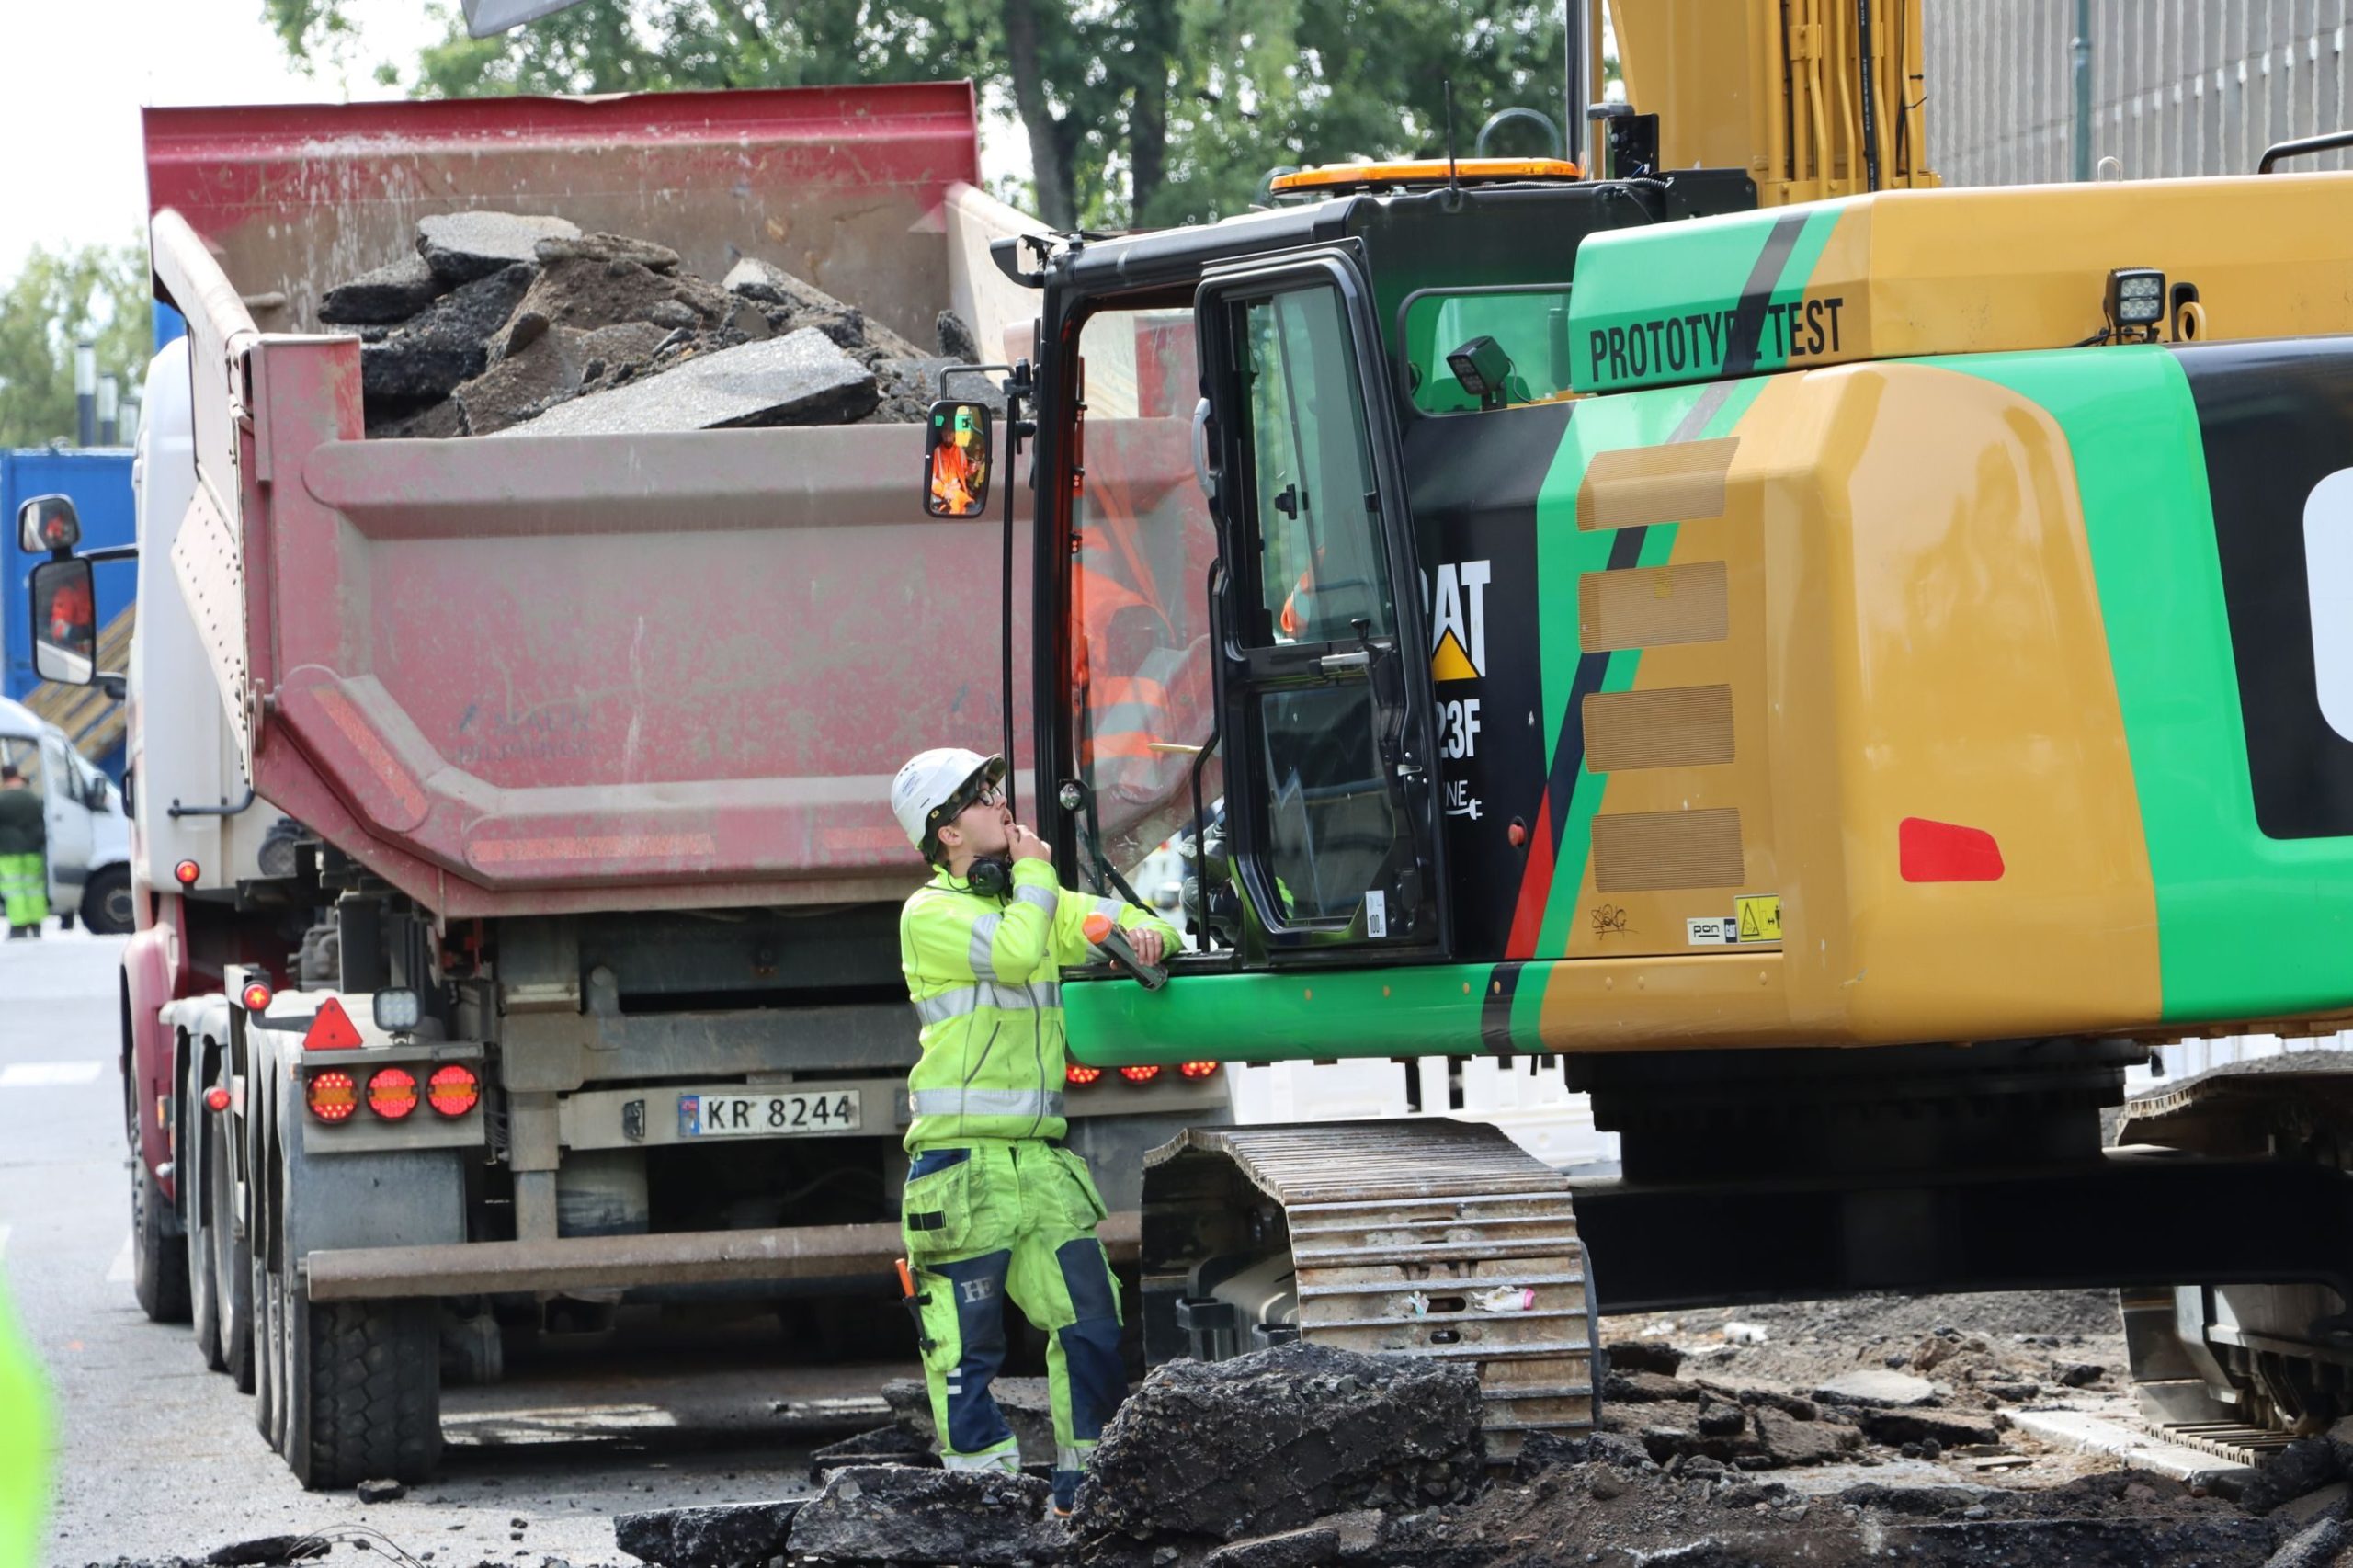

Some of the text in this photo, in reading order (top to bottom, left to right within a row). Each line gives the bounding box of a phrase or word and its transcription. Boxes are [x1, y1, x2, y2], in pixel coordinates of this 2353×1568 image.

[1590, 298, 1843, 382] PROTOTYP TEST
[1369, 914, 1380, 935] 100
[1694, 925, 1719, 938] pon
[708, 1096, 850, 1129] KR 8244
